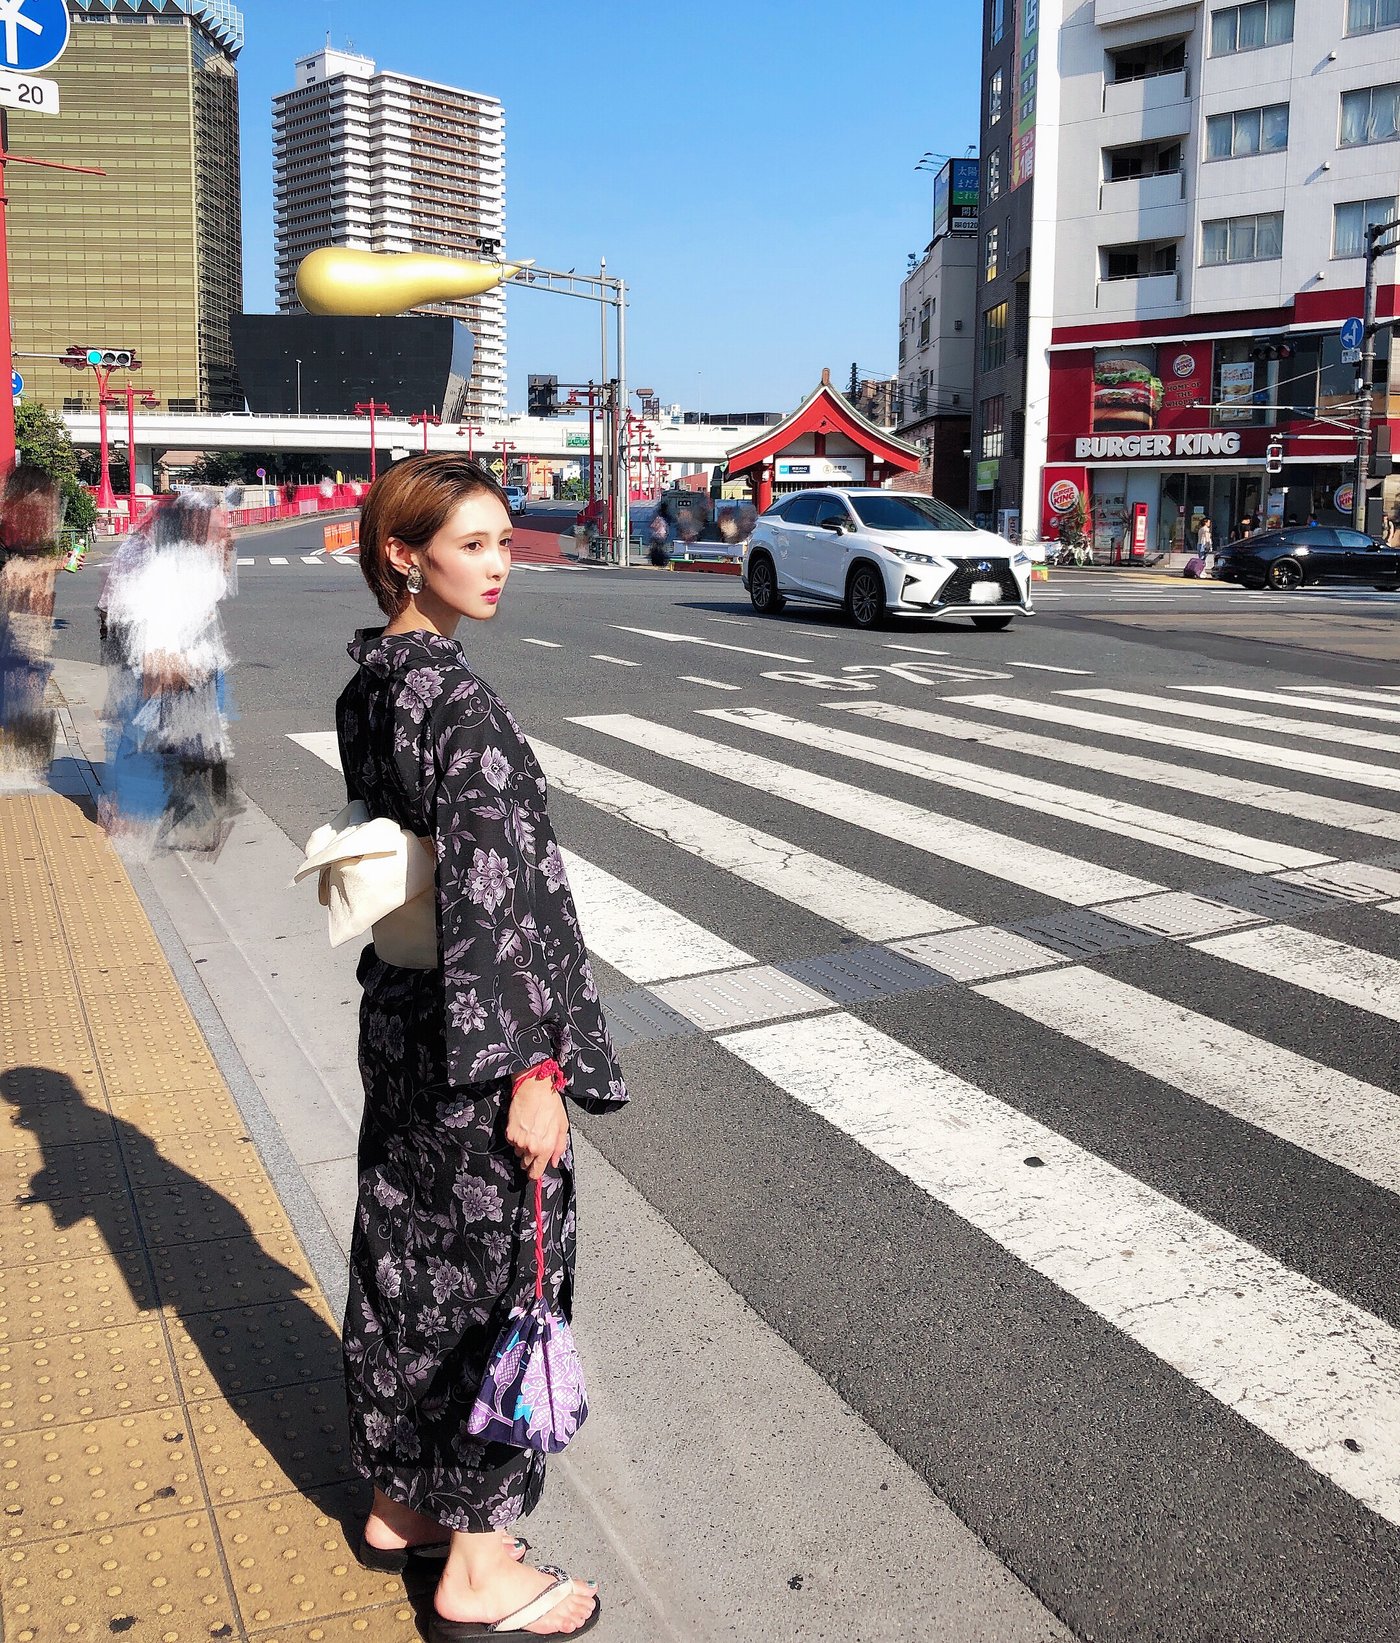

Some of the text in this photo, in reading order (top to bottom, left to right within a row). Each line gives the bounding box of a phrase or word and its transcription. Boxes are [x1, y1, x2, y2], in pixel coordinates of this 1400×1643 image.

[958, 166, 979, 177] 太陽
[1167, 383, 1190, 392] HOME
[1176, 390, 1193, 398] THE
[1075, 432, 1241, 459] BURGER KING
[1053, 486, 1074, 498] BURGER
[1053, 492, 1075, 505] KING
